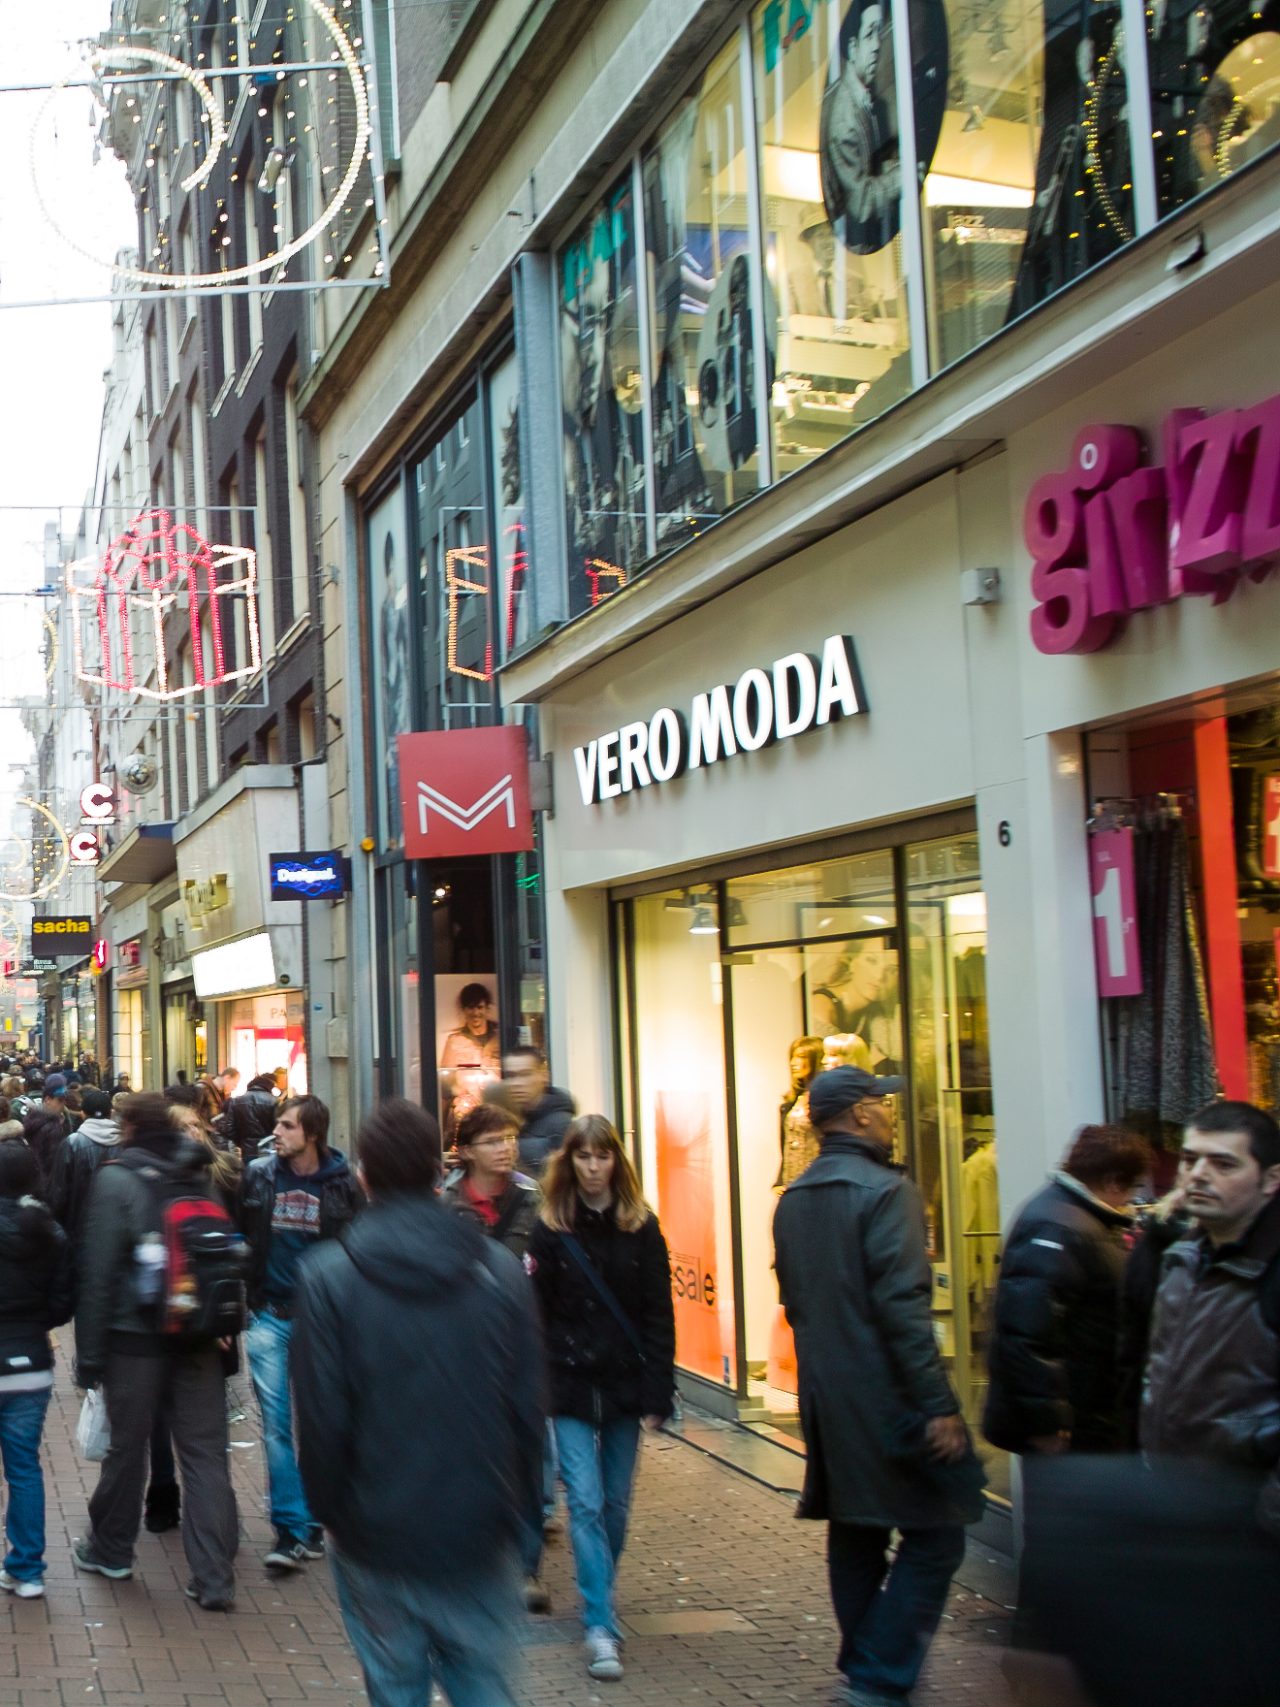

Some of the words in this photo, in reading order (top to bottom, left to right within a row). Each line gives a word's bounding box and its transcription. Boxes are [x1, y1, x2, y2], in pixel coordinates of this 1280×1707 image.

[947, 210, 985, 229] jazz
[574, 706, 684, 806] VERO
[688, 634, 863, 771] MODA
[998, 820, 1012, 848] 6
[33, 918, 90, 935] sacha
